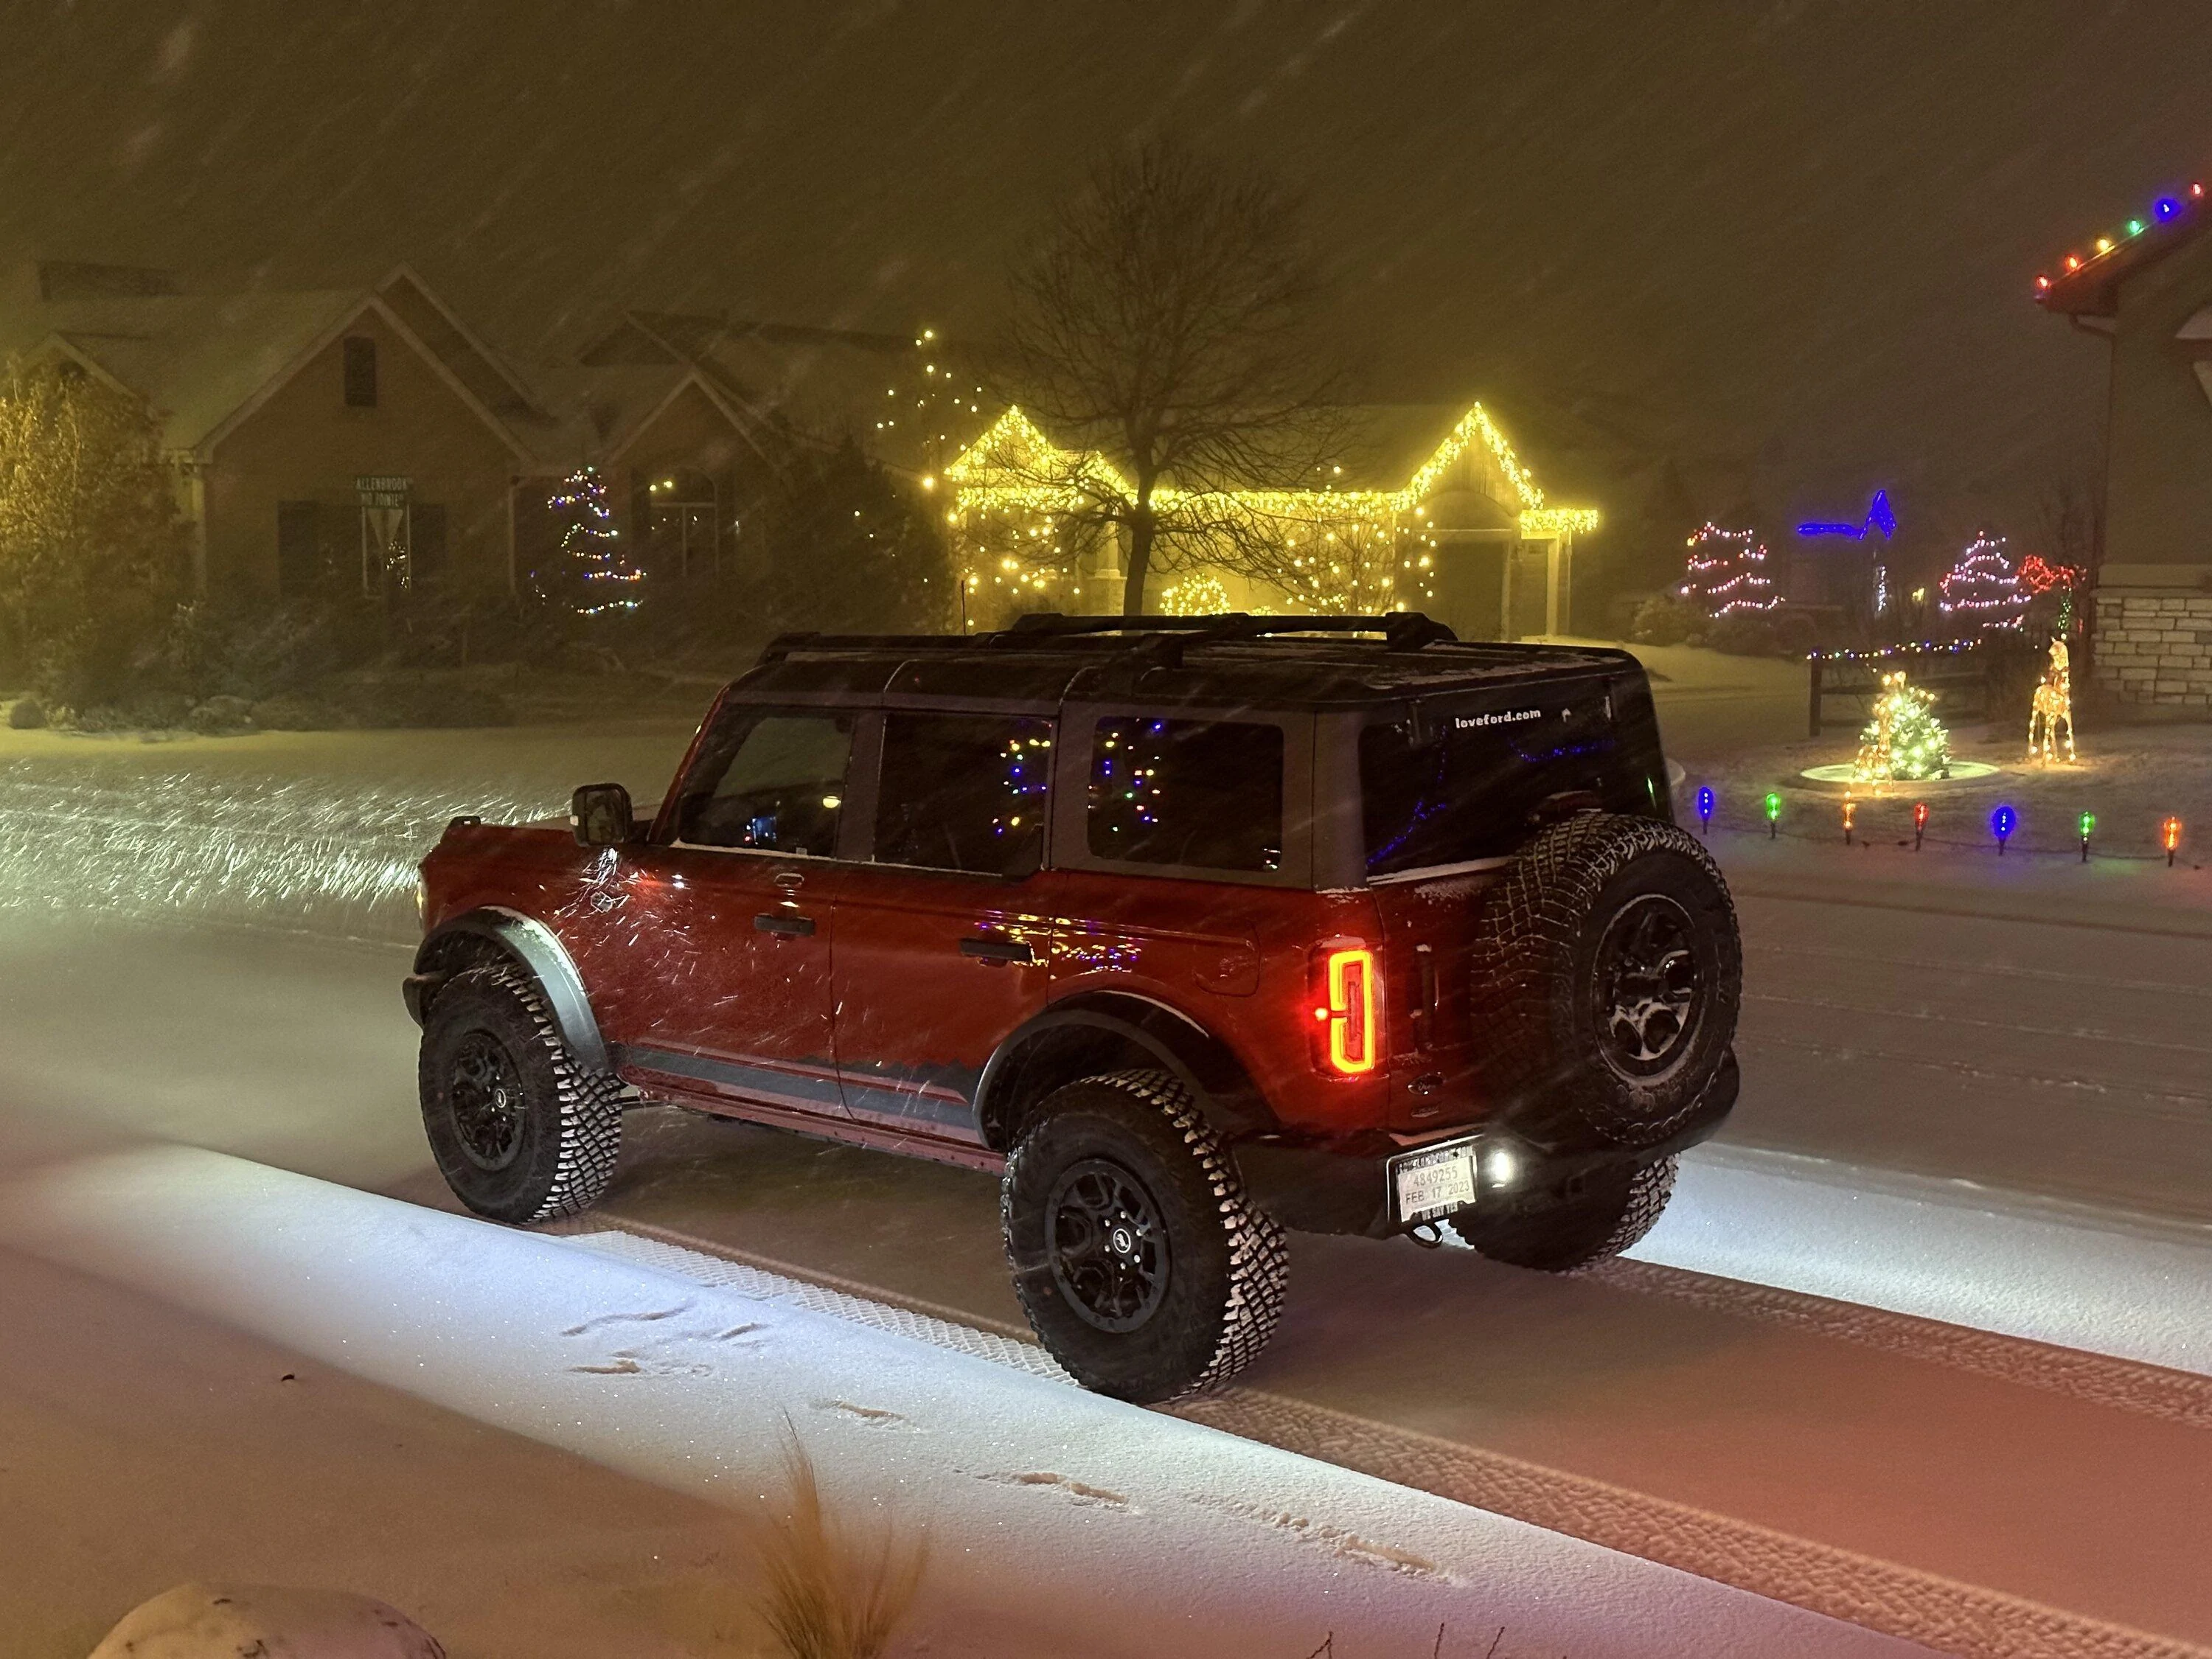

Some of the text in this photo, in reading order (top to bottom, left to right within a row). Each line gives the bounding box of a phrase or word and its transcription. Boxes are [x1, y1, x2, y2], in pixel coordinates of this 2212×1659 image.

[1455, 709, 1542, 729] loveford.com
[1413, 1166, 1458, 1186] 4849255
[1405, 1180, 1470, 1205] FEB 17 2023
